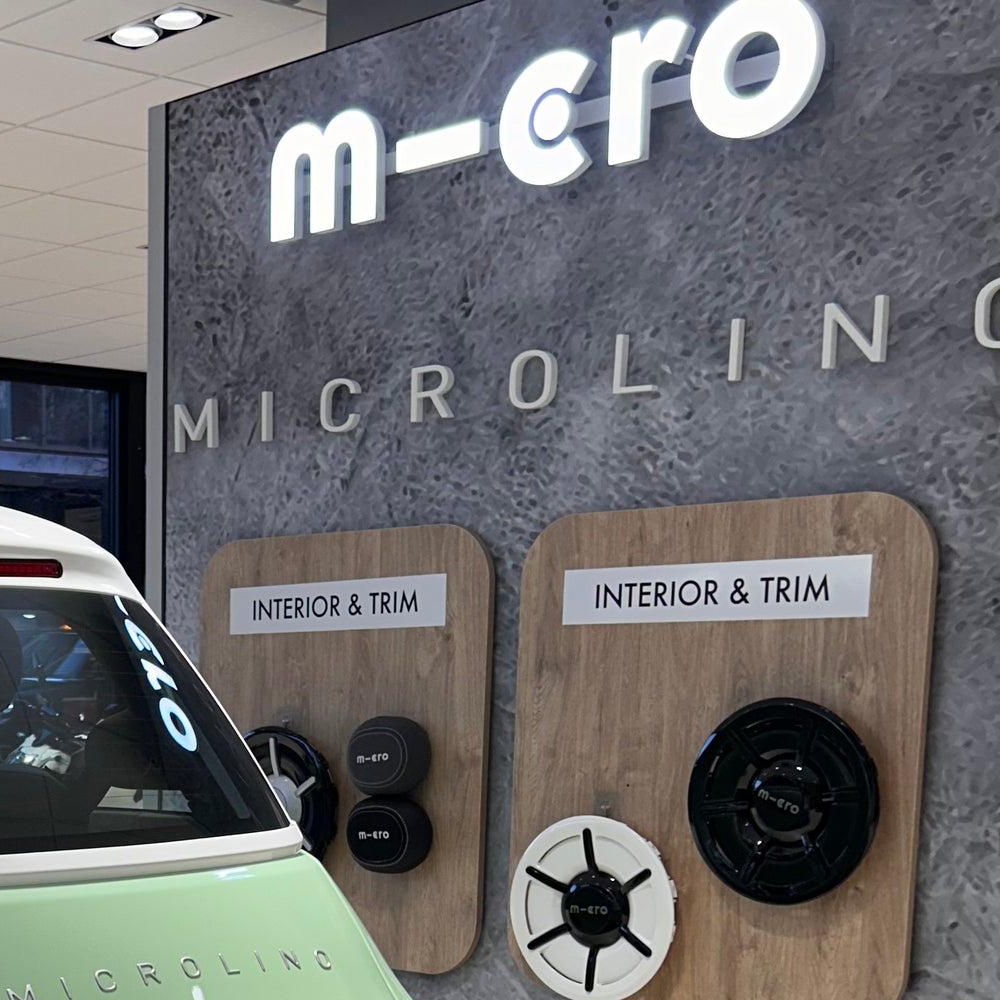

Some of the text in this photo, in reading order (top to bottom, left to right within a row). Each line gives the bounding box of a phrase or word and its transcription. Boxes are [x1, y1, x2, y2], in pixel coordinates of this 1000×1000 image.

[252, 589, 418, 621] INTERIOR & TRIM
[595, 573, 830, 609] INTERIOR & TRIM
